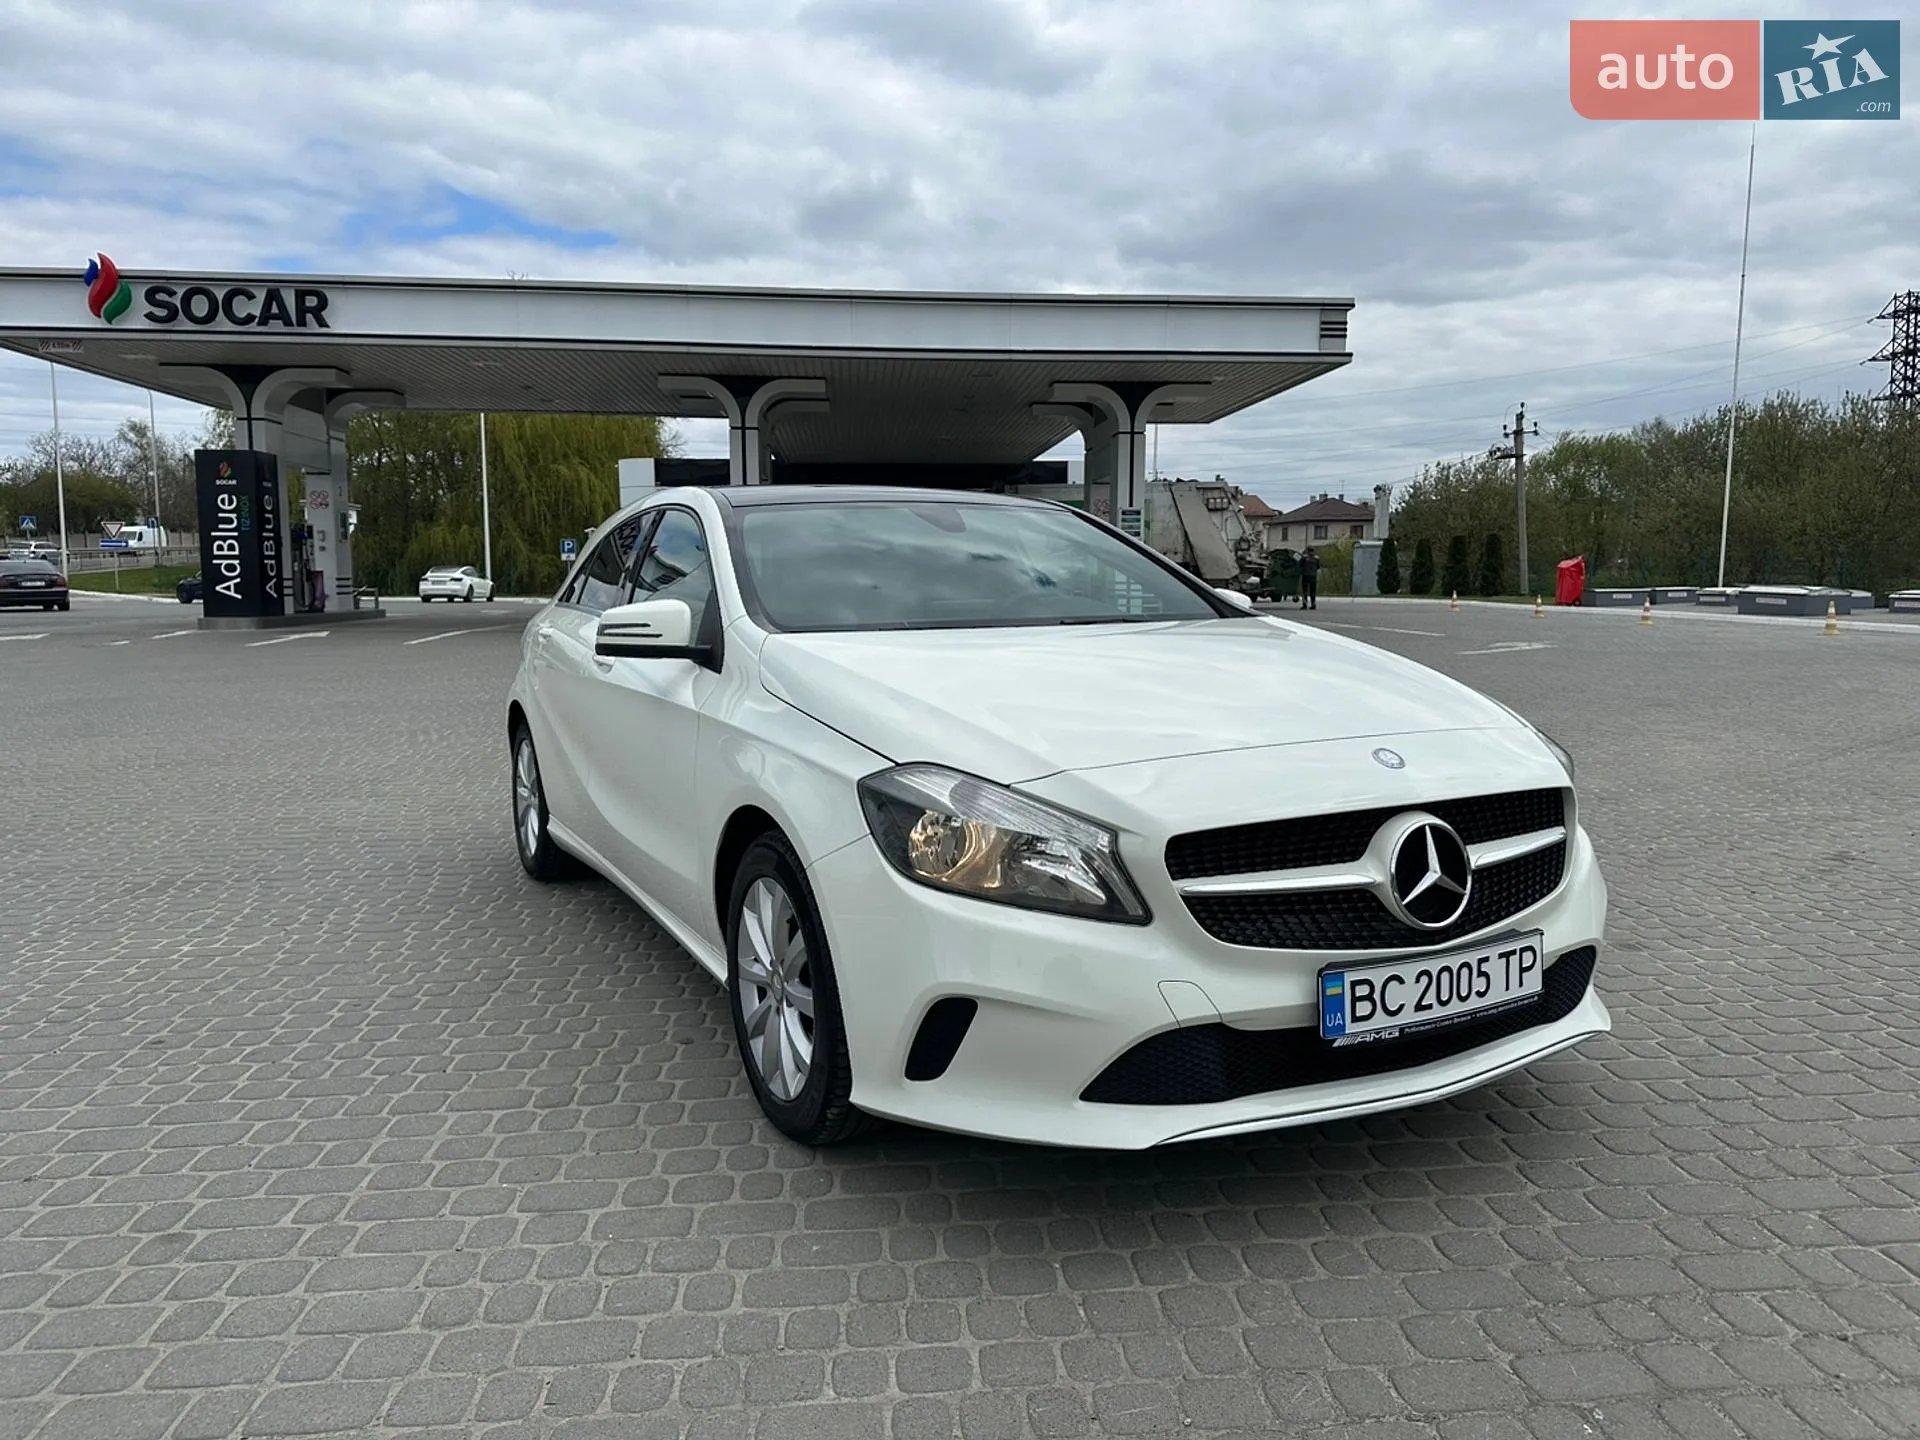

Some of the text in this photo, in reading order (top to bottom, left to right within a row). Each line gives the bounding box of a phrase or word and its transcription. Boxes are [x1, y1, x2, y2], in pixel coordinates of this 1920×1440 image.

[143, 285, 331, 329] SOCAR
[210, 493, 242, 600] AdBlue
[263, 495, 278, 599] AdBlue
[564, 541, 573, 552] P
[1349, 974, 1406, 1024] BC
[1414, 956, 1491, 1012] 2005
[1498, 945, 1538, 991] TP
[1326, 1012, 1343, 1027] UA
[1355, 1026, 1400, 1043] AMG
